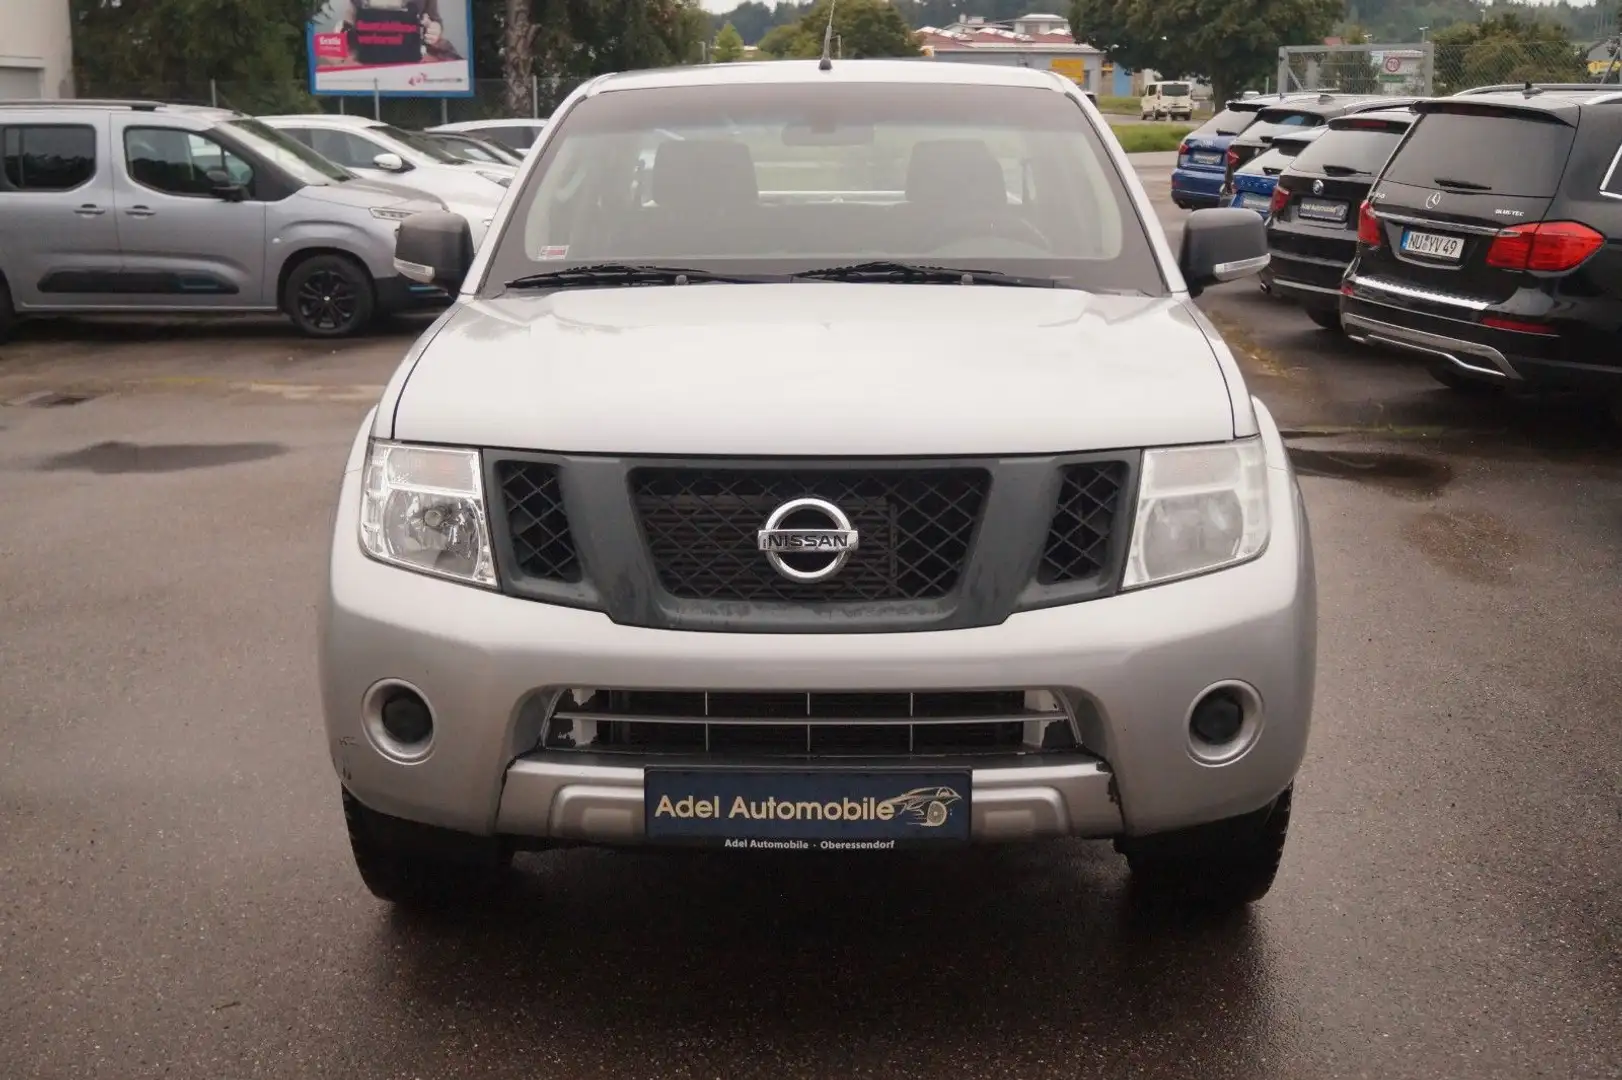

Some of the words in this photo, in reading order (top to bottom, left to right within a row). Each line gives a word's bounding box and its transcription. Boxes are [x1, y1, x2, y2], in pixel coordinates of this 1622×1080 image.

[1443, 239, 1458, 255] 49
[768, 535, 848, 547] NISSAN
[655, 795, 720, 818] Adel
[728, 796, 895, 820] Automobile
[724, 838, 748, 848] Adel
[750, 838, 809, 849] Automobile
[820, 840, 895, 849] Oberessendorf
